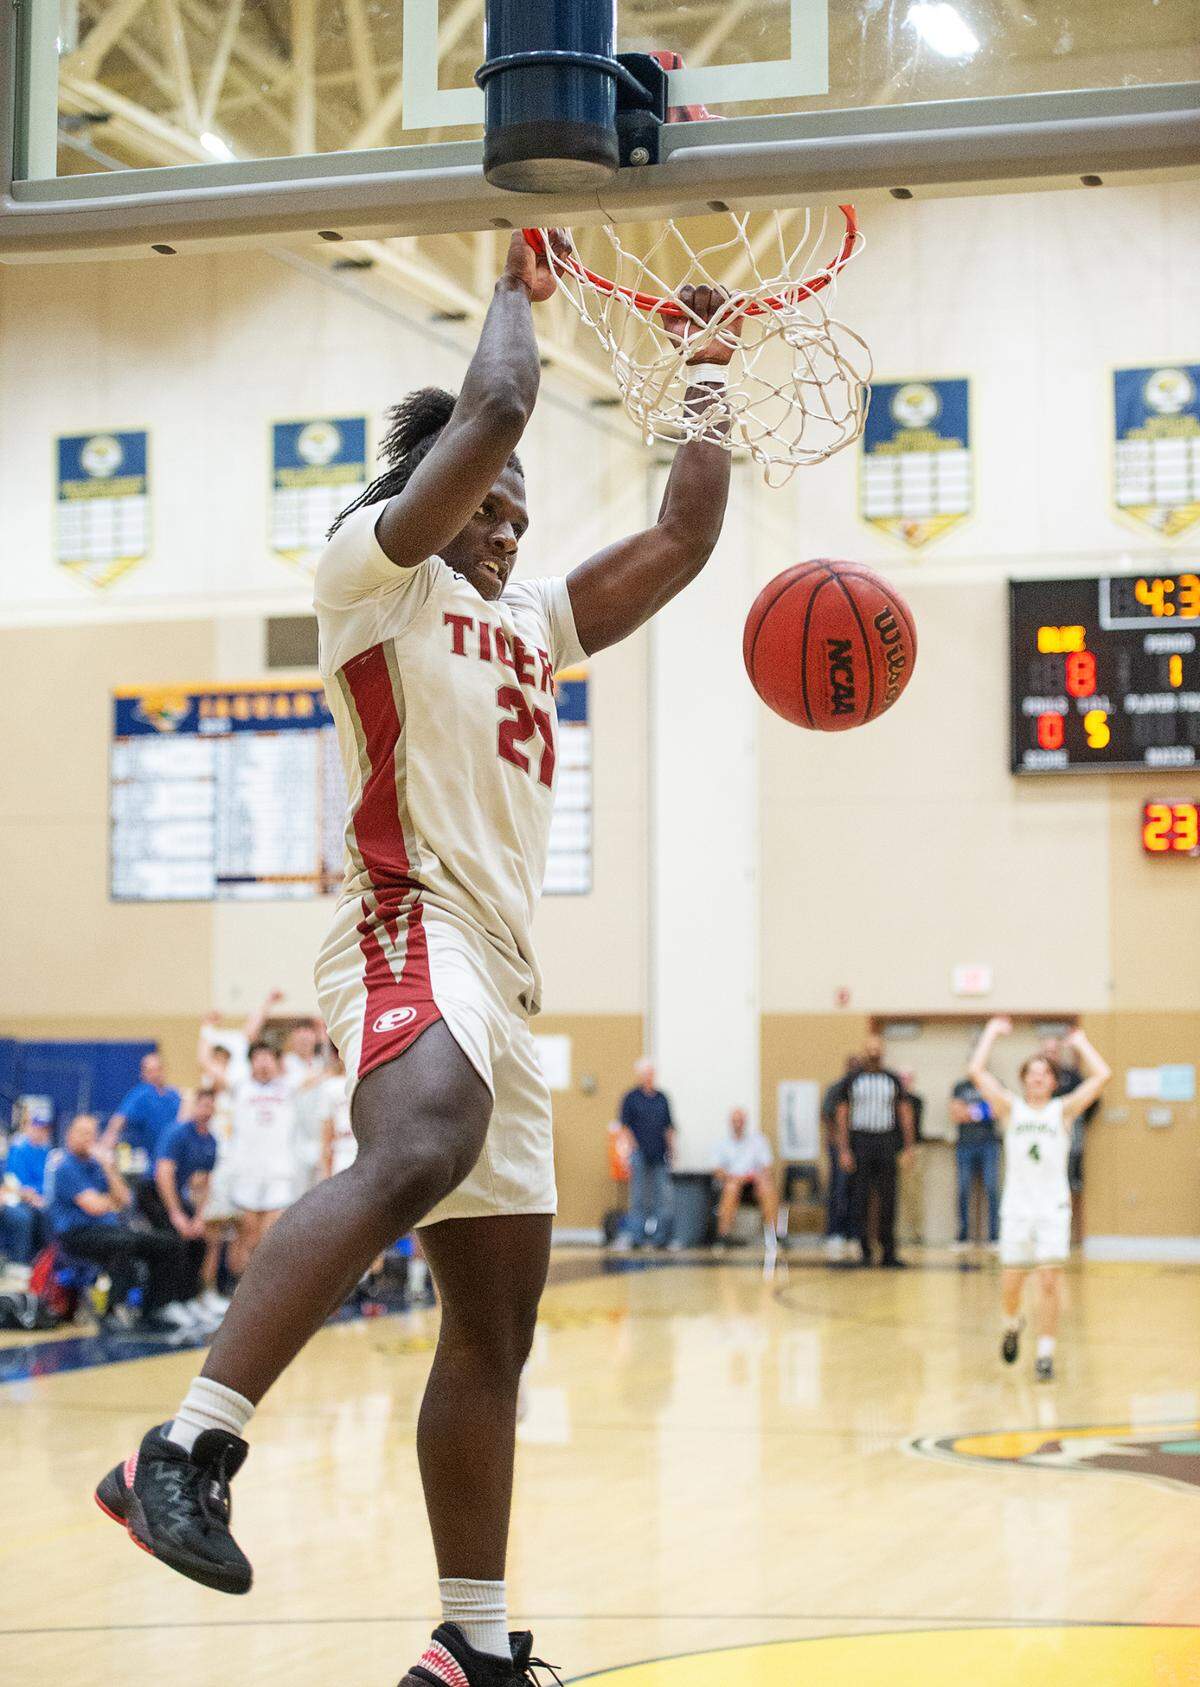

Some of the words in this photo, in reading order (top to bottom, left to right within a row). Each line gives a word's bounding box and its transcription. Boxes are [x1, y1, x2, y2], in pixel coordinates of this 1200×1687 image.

[827, 639, 855, 716] NCAA
[1065, 650, 1097, 698] 8
[1168, 654, 1183, 688] 1
[1037, 711, 1065, 750] 0
[1083, 709, 1110, 749] 5
[1143, 803, 1198, 851] 23
[1028, 1143, 1041, 1162] 4
